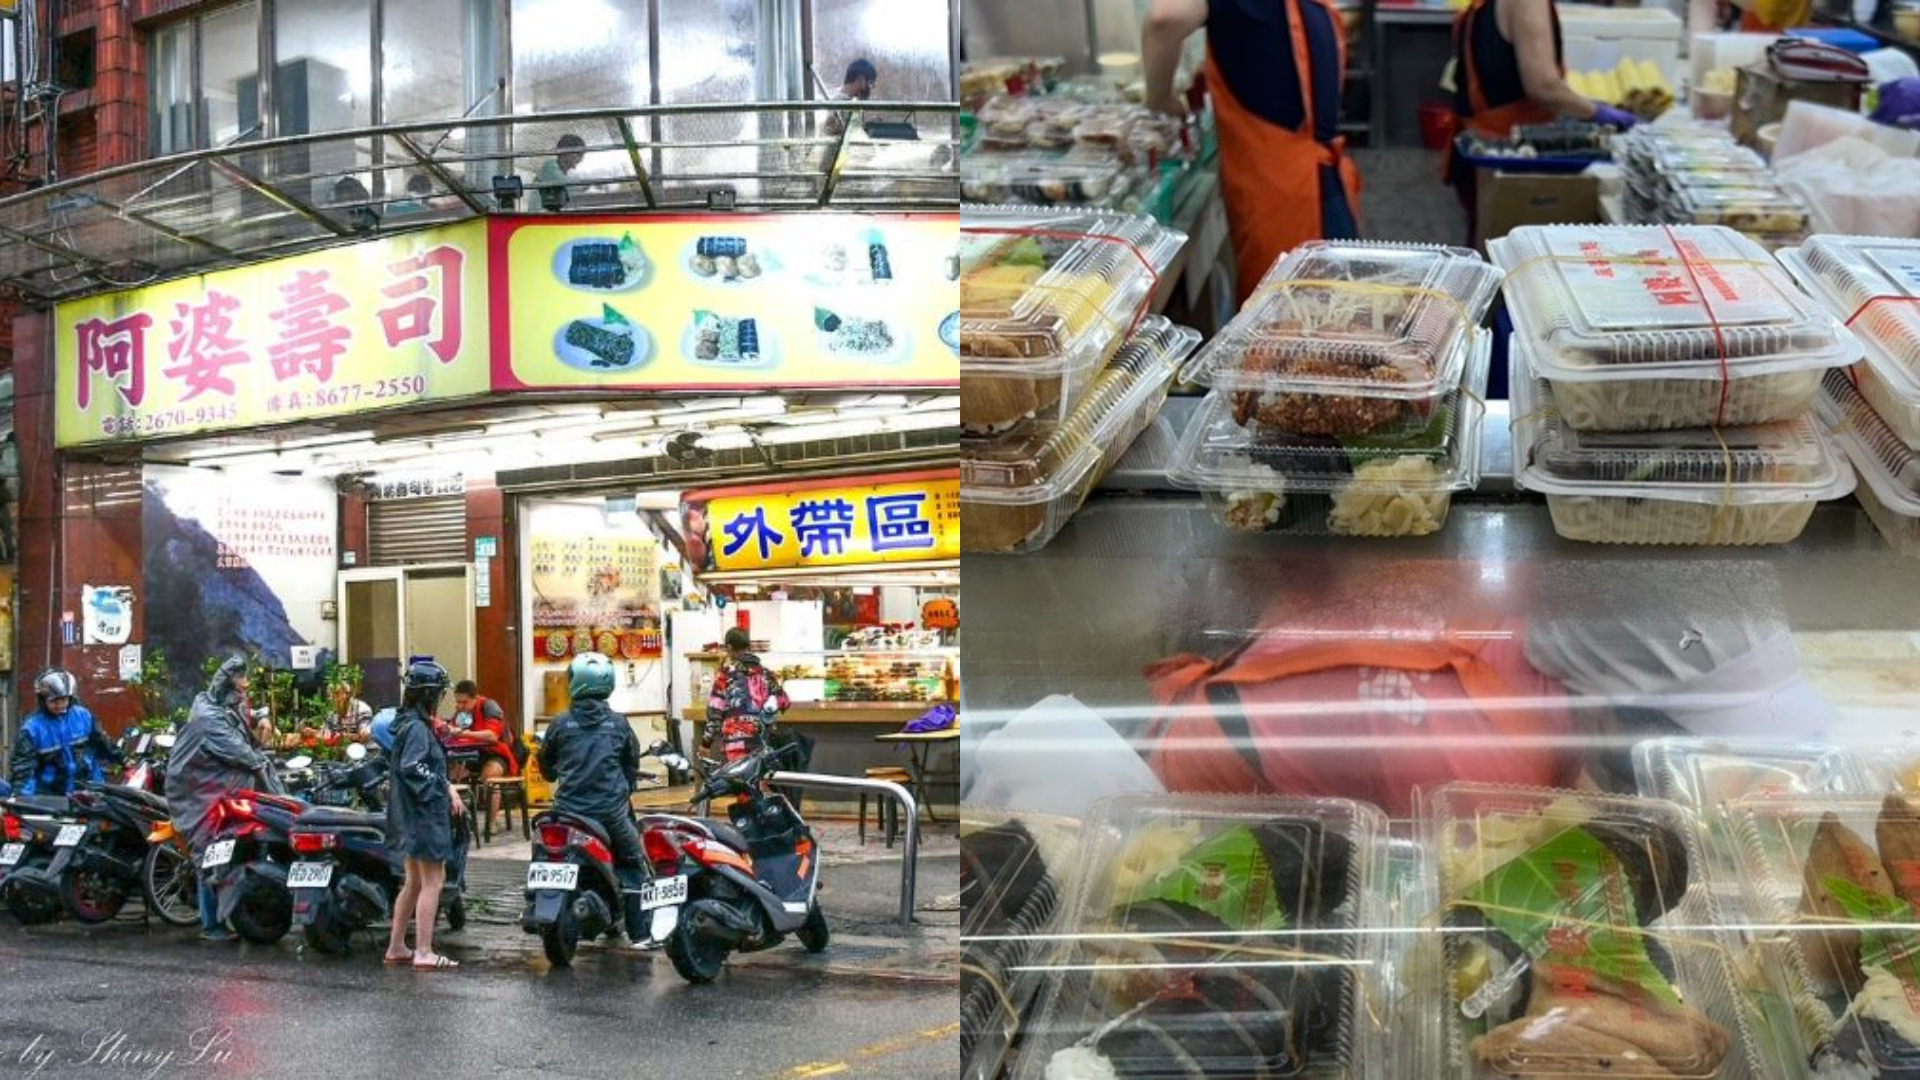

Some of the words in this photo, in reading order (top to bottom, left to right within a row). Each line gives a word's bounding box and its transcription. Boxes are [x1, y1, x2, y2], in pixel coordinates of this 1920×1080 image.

[76, 246, 464, 410] 阿婆壽司
[723, 493, 933, 559] 外帶區
